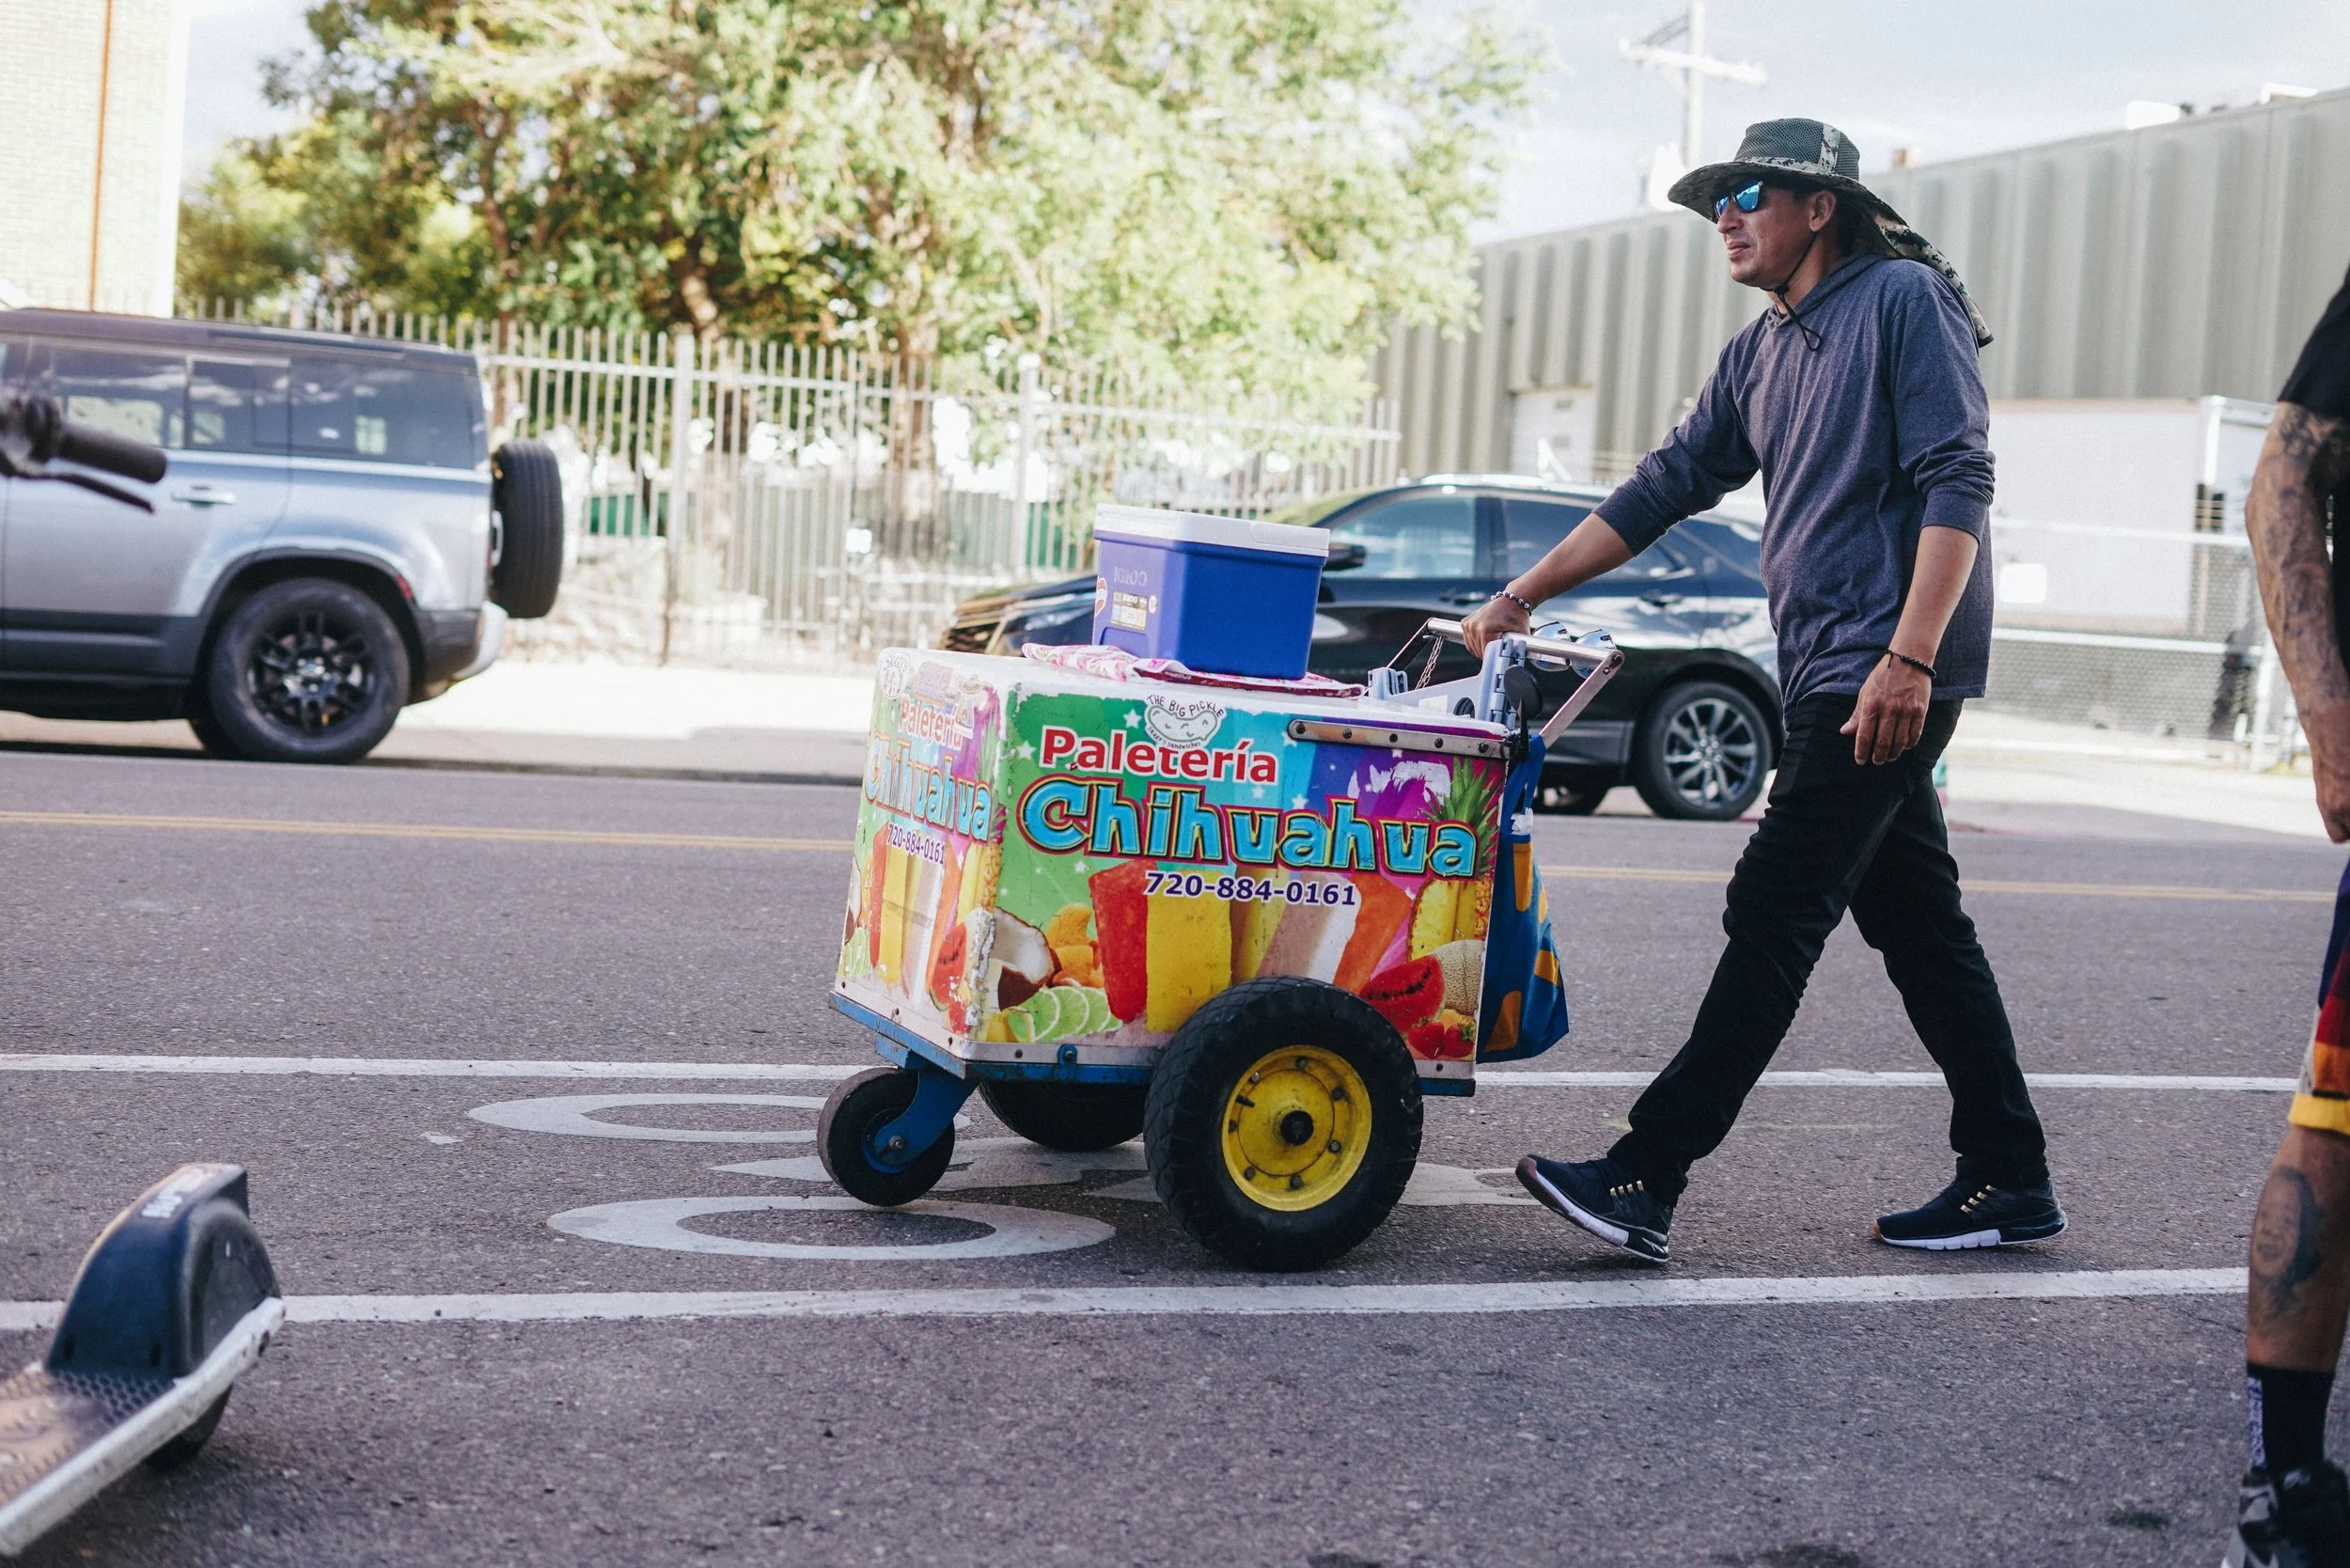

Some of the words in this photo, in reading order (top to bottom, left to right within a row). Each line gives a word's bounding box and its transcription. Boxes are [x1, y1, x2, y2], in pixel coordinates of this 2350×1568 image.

[1147, 695, 1167, 707] THE
[1168, 700, 1185, 717] BIG
[1189, 700, 1225, 718] PICKLE
[1042, 727, 1278, 783] Paletería
[866, 732, 992, 843] Chihuahua
[888, 823, 945, 865] 720-884-0161
[1020, 776, 1479, 879] Chihuahua
[1145, 871, 1356, 906] 720-884-0161
